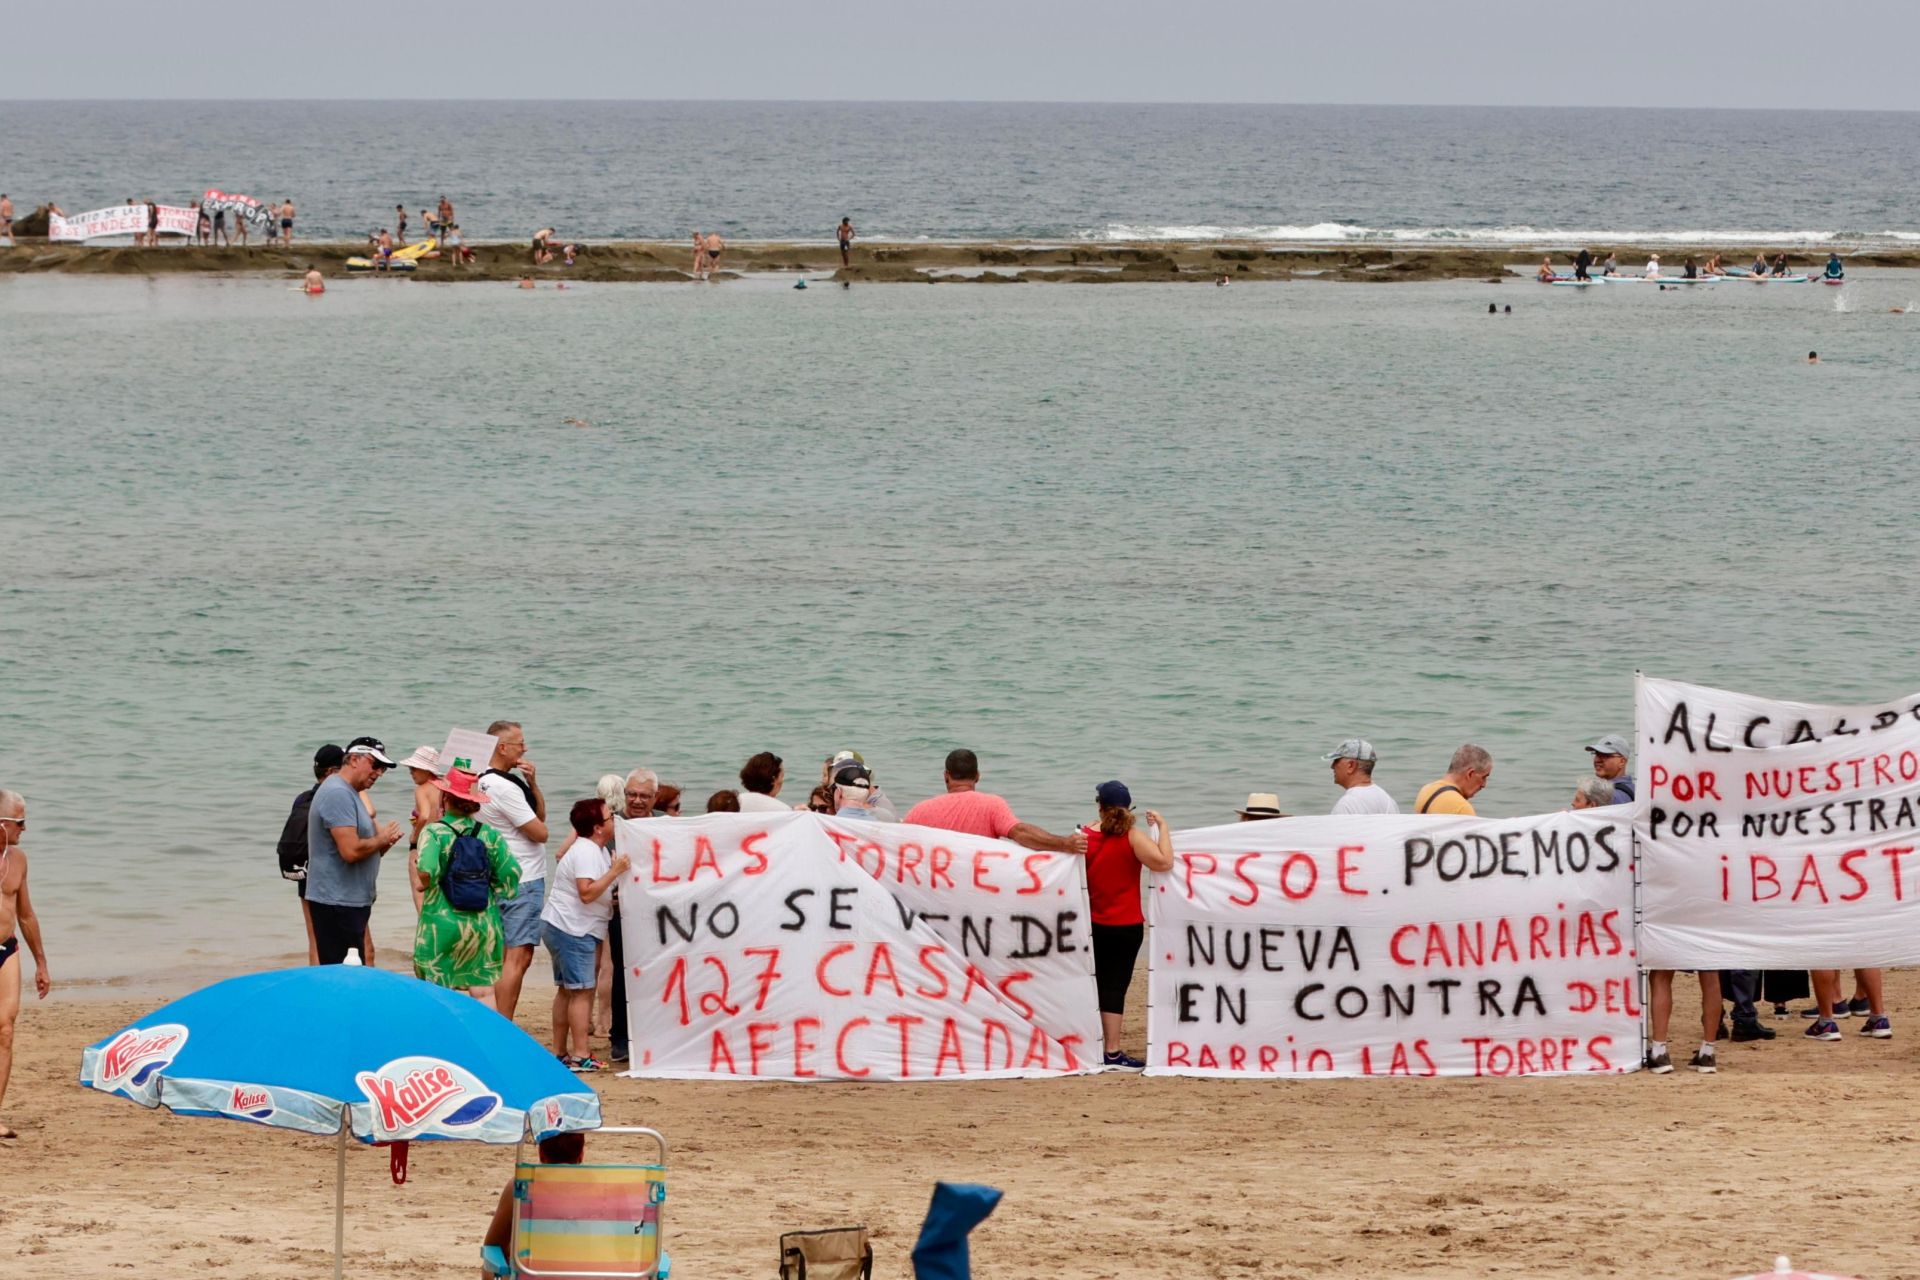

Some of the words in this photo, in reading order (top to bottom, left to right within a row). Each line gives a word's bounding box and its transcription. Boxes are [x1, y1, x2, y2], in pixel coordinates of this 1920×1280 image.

[1650, 765, 1722, 801] POR
[1745, 751, 1918, 799] NUESTRO
[1650, 807, 1719, 840] POR
[1743, 797, 1920, 838] NUESTRA
[652, 831, 768, 883] LAS
[1720, 846, 1920, 904] ¡BAST
[656, 902, 739, 945] NO
[780, 887, 858, 930] SE
[1187, 924, 1360, 972] NUEVA
[661, 946, 782, 1026] 127
[815, 941, 1034, 1021] CASAS
[1177, 983, 1247, 1025] EN
[1293, 975, 1547, 1021] CONTRA
[1567, 975, 1641, 1017] DEL
[103, 1033, 179, 1080] Kalise
[1360, 1038, 1438, 1078] LAS
[233, 1087, 267, 1110] Kalise
[365, 1067, 456, 1130] Kalise
